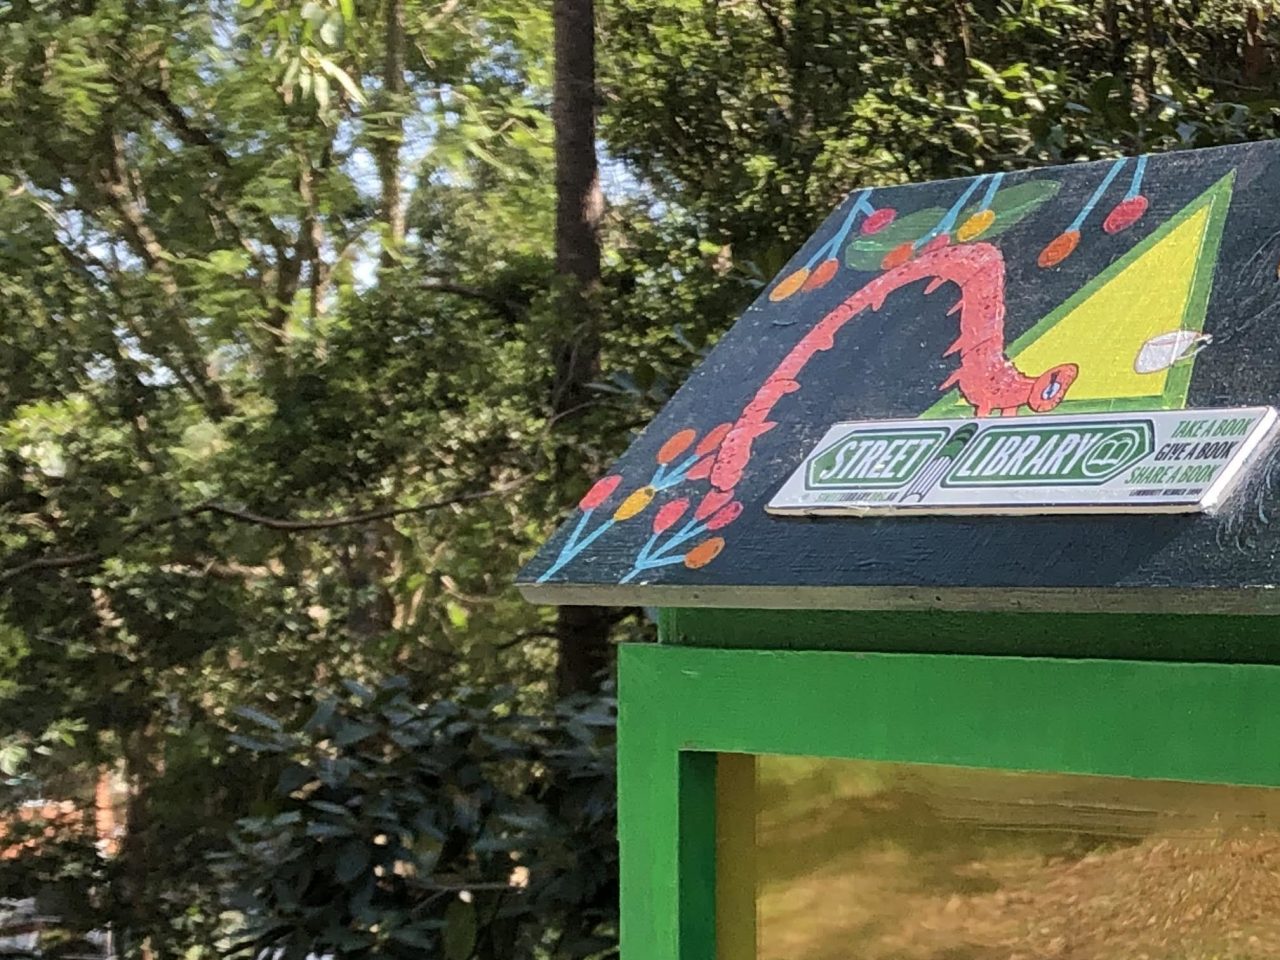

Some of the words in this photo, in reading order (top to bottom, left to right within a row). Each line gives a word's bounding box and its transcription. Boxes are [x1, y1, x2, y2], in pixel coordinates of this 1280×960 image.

[1171, 419, 1208, 438] TAKE
[1199, 419, 1217, 437] A
[1212, 417, 1256, 437] BOOK
[820, 438, 937, 480] STREET
[956, 432, 1103, 477] LIBRARY
[1154, 442, 1191, 461] GIVE
[1184, 441, 1201, 460] A
[1194, 440, 1240, 460] BOOK
[1125, 465, 1174, 484] SHARE
[1166, 465, 1183, 483] A
[1177, 463, 1221, 483] BOOK
